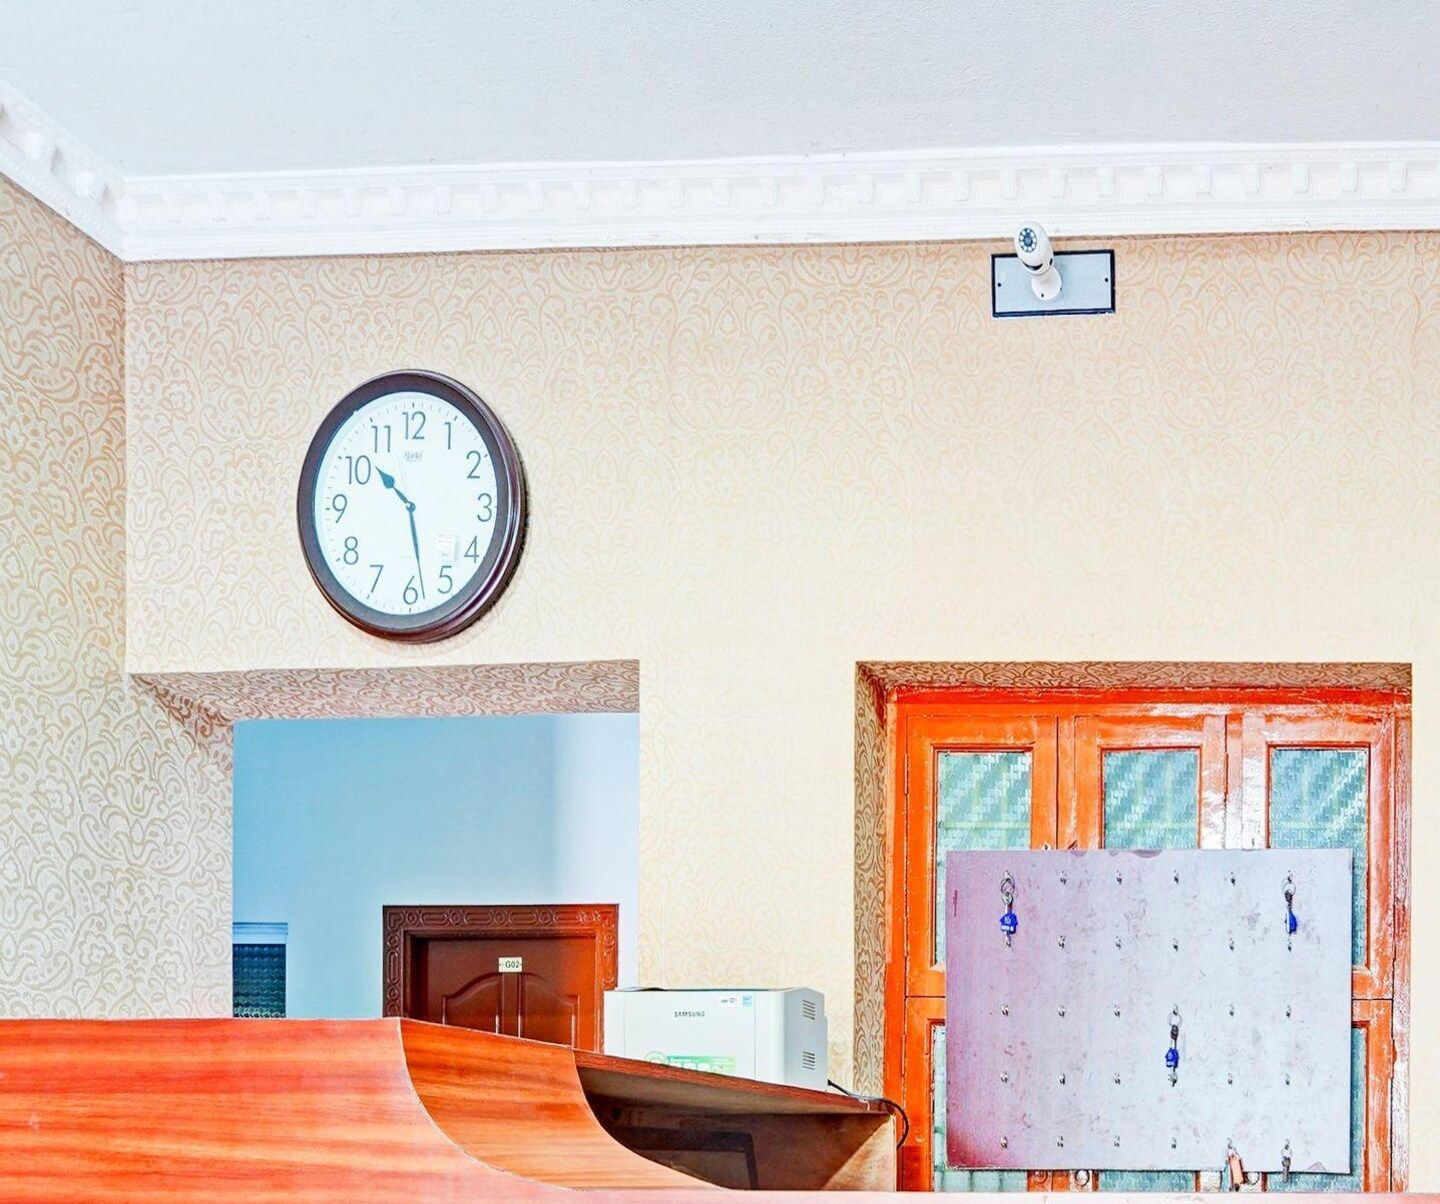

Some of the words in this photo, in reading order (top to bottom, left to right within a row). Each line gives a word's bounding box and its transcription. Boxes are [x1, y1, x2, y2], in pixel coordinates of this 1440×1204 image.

[371, 425, 391, 453] 11
[402, 411, 426, 440] 12
[443, 421, 452, 450] 1
[345, 454, 371, 485] 10
[466, 450, 481, 479] 2
[332, 493, 348, 523] 9
[476, 493, 493, 522] 3
[343, 536, 359, 565] 8
[463, 535, 480, 563] 4
[369, 564, 385, 593] 7
[402, 575, 419, 605] 6
[437, 565, 453, 594] 5
